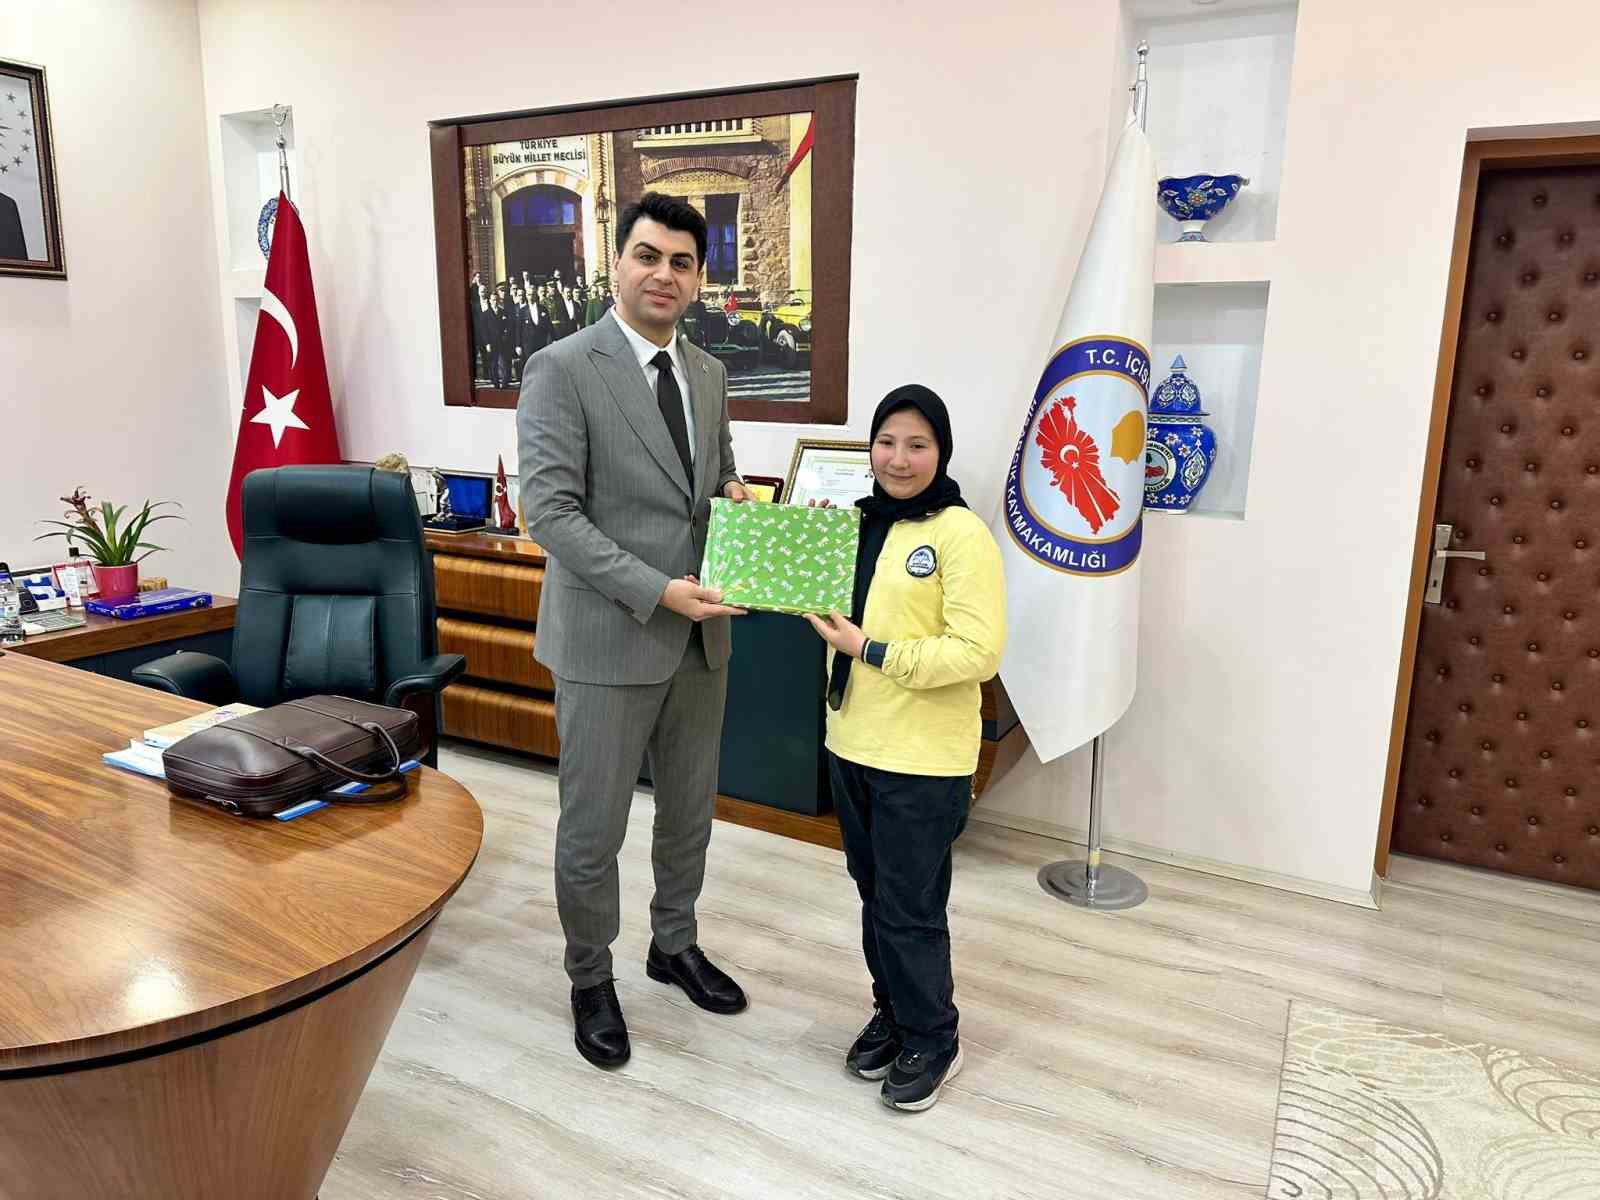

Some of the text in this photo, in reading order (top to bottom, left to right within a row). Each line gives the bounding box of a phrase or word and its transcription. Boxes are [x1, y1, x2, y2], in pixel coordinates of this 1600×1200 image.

[493, 153, 521, 164] BÜYÜK
[524, 152, 551, 163] MİLLET
[1085, 348, 1120, 366] T.C.
[1007, 485, 1107, 568] KAYMAKAMLIĞI
